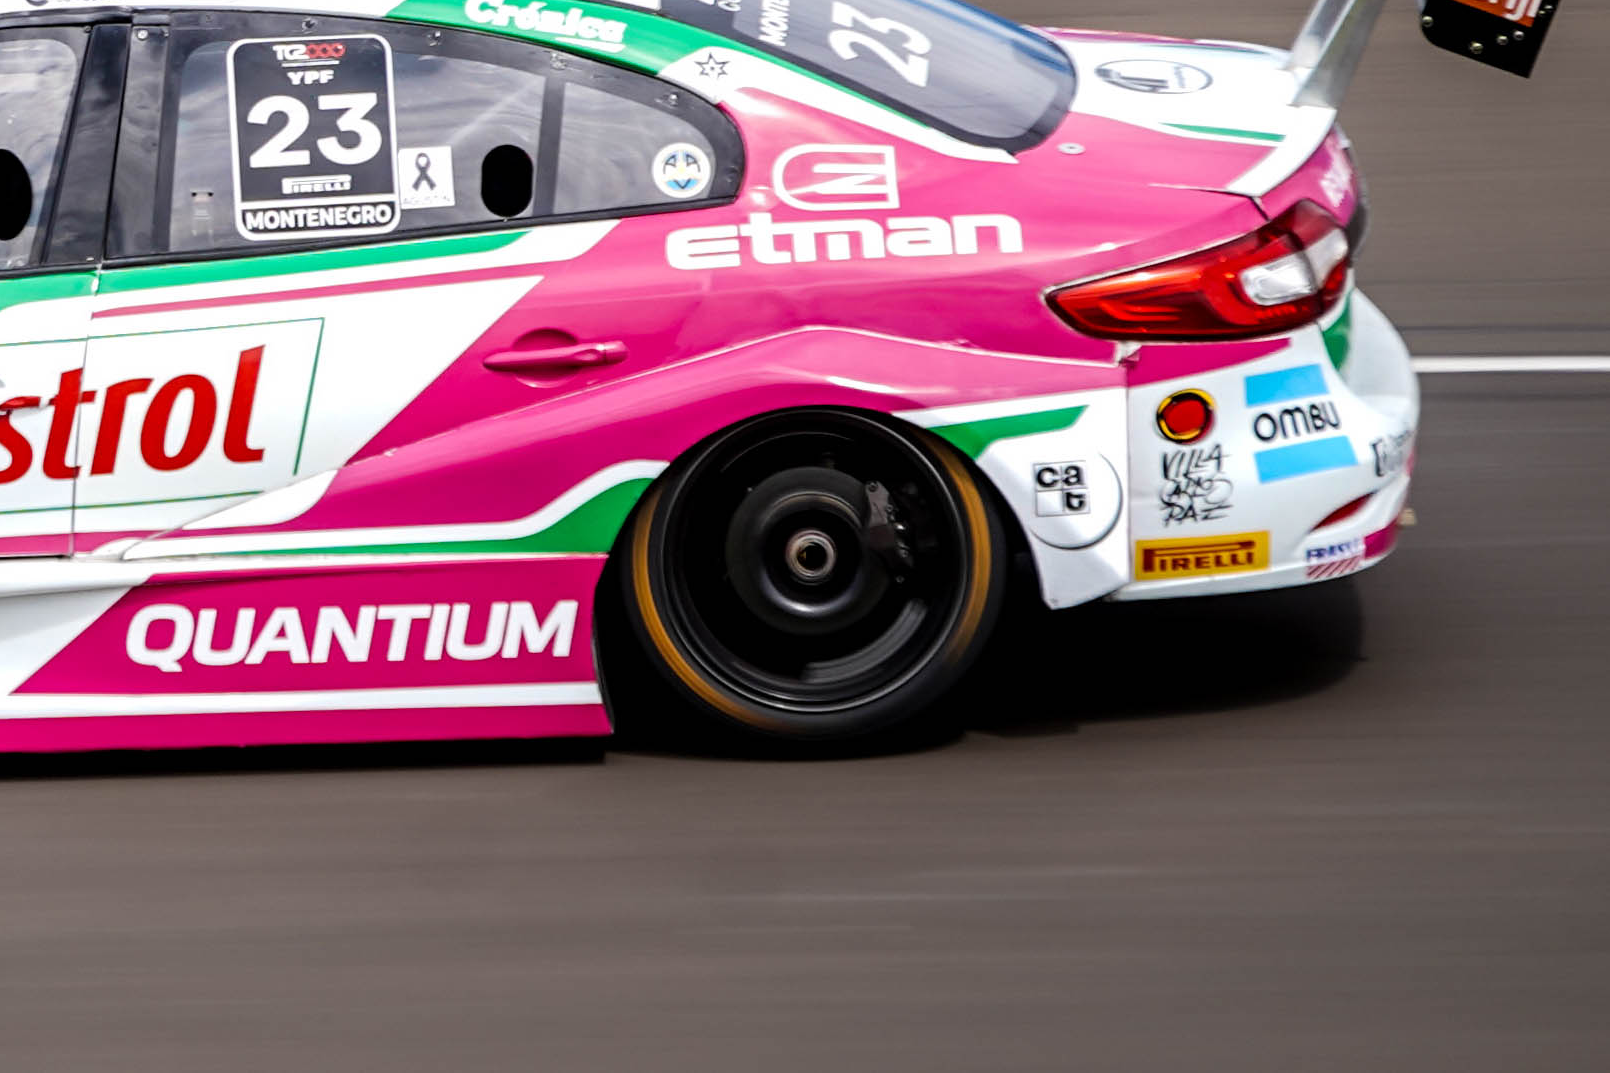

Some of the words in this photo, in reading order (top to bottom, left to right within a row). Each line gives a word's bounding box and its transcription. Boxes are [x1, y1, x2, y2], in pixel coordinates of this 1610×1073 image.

[828, 1, 932, 87] 23
[287, 70, 334, 85] YPF
[247, 92, 383, 168] 23
[245, 204, 392, 230] MONTENEGRO
[1142, 540, 1255, 573] PIRELLI
[125, 599, 579, 673] QUANTIUM
